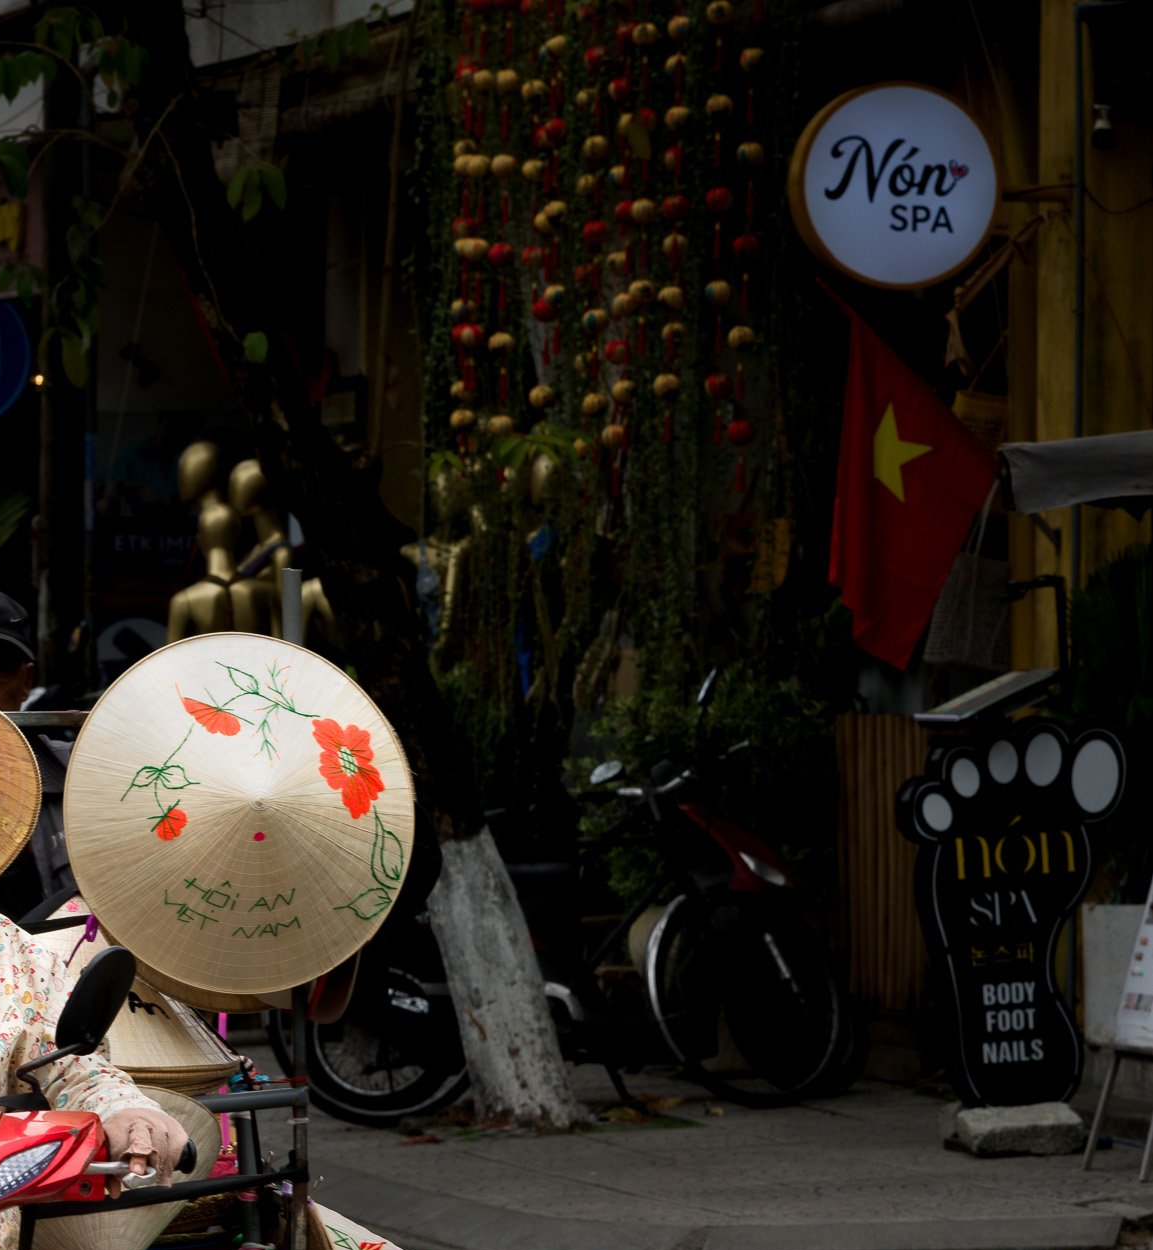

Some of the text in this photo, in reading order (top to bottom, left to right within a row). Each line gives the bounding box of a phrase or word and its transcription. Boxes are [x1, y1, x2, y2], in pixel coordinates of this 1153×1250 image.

[824, 135, 957, 204] Nón
[890, 204, 953, 234] SPA
[248, 887, 296, 912] AN
[968, 888, 1039, 927] SPA
[231, 915, 302, 940] NAM
[981, 980, 1036, 1007] BODY
[984, 1007, 1036, 1034] FOOT
[981, 1037, 1045, 1066] NAILS
